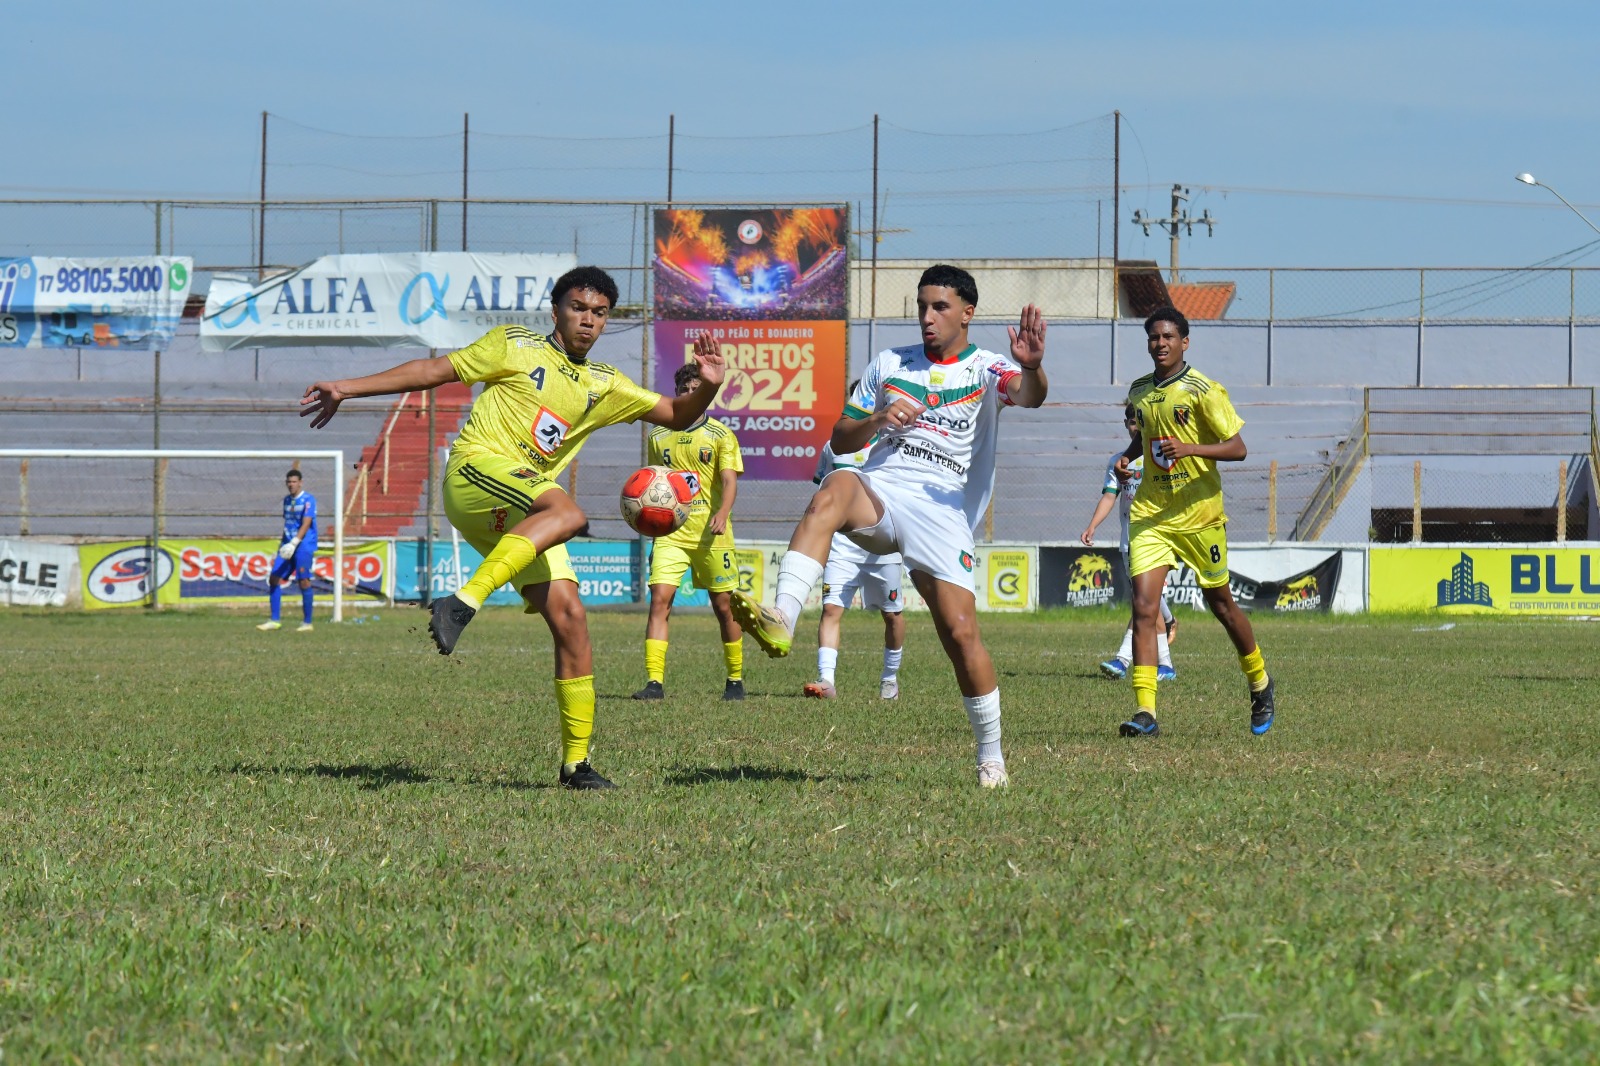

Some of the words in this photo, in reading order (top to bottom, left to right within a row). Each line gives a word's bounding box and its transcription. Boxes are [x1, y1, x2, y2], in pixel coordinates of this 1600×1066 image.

[40, 275, 53, 292] 17
[57, 266, 163, 293] 98105.5000
[272, 276, 376, 314] ALFA
[0, 316, 17, 341] S
[287, 318, 361, 330] CHEMICAL
[475, 315, 550, 326] CHEMICAL
[713, 328, 725, 338] DO
[728, 326, 750, 338] PEÃO
[754, 328, 764, 338] DE
[768, 328, 814, 338] BOIADEIRO
[684, 343, 815, 369] RRETOS
[707, 368, 817, 411] 024
[744, 416, 816, 431] AGOSTO
[663, 448, 672, 466] 5
[903, 444, 933, 462] SANTA
[1161, 471, 1190, 482] SPORTS
[723, 552, 731, 569] 5
[1210, 544, 1221, 564] 8
[181, 548, 381, 588] Saveago
[595, 565, 630, 573] ESPORTE
[577, 579, 650, 597] 8102-5
[1066, 585, 1115, 602] FANÁTICOS
[1509, 601, 1569, 610] CONSTRUTORA
[1571, 601, 1577, 610] E
